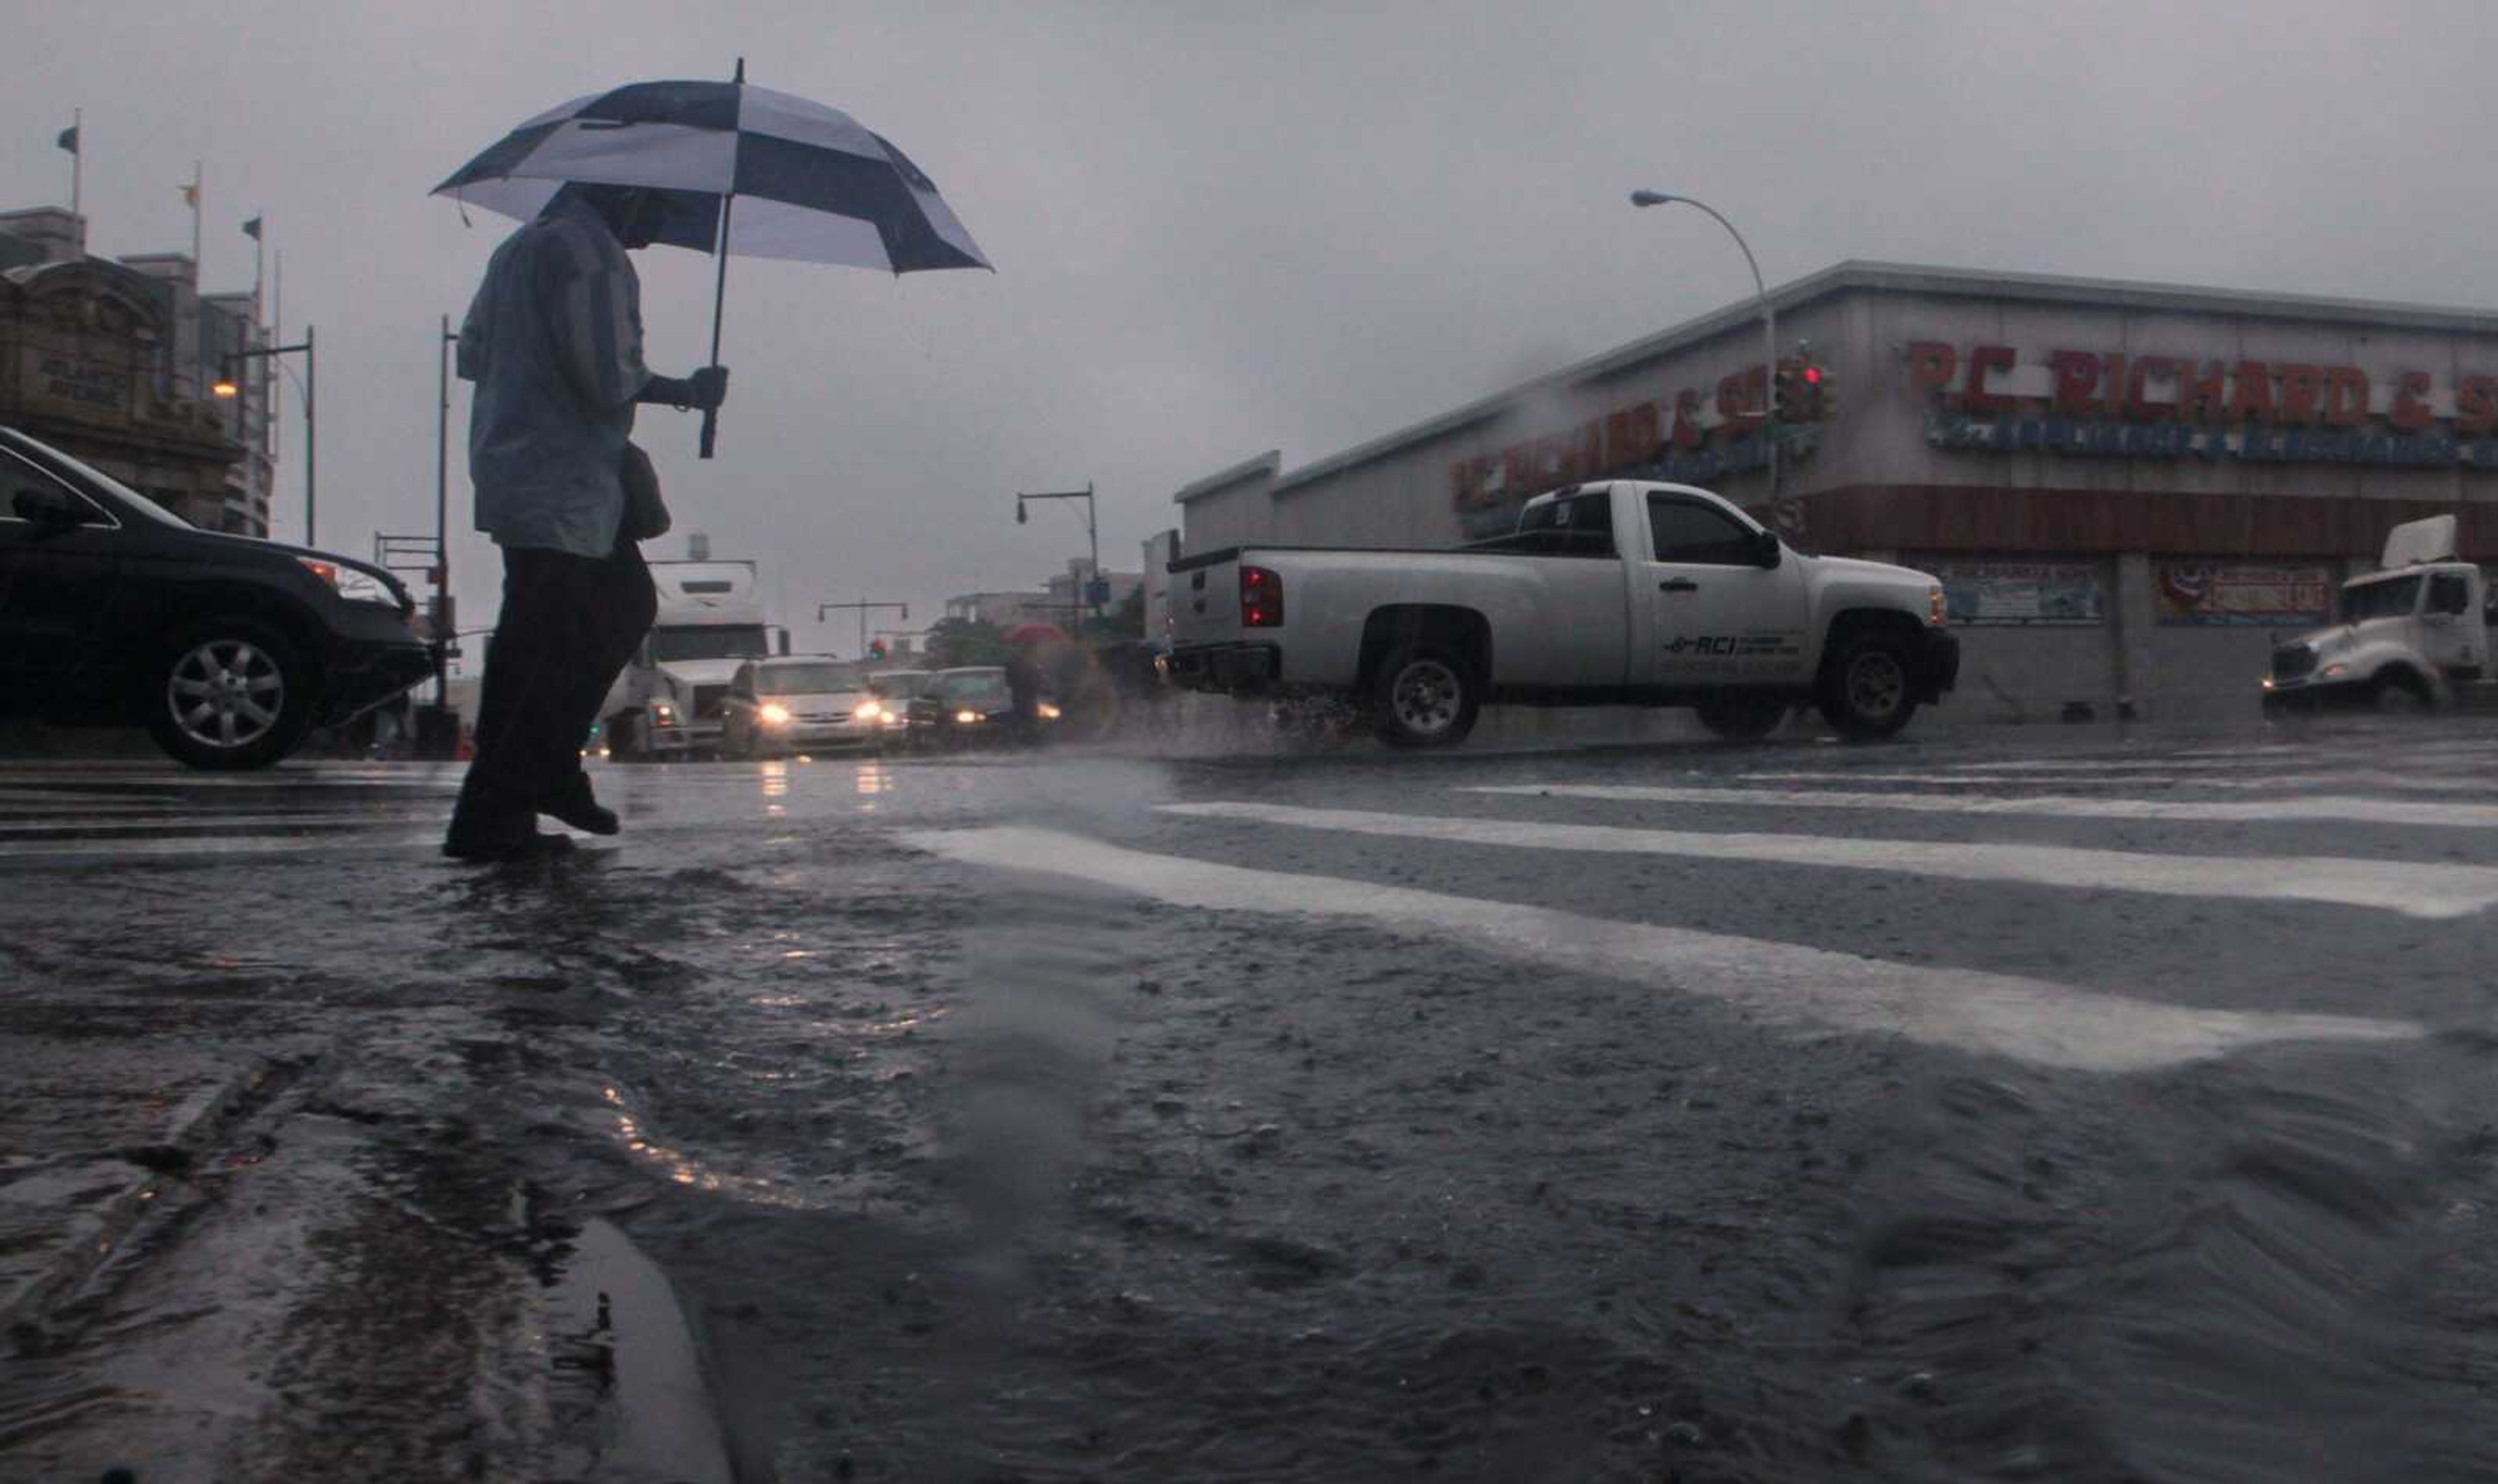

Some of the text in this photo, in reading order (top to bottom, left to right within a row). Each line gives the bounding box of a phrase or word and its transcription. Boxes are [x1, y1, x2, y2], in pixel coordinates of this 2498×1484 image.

[2052, 349, 2369, 424] RICHARD
[2389, 373, 2434, 427] &
[1695, 635, 1737, 655] RCI
